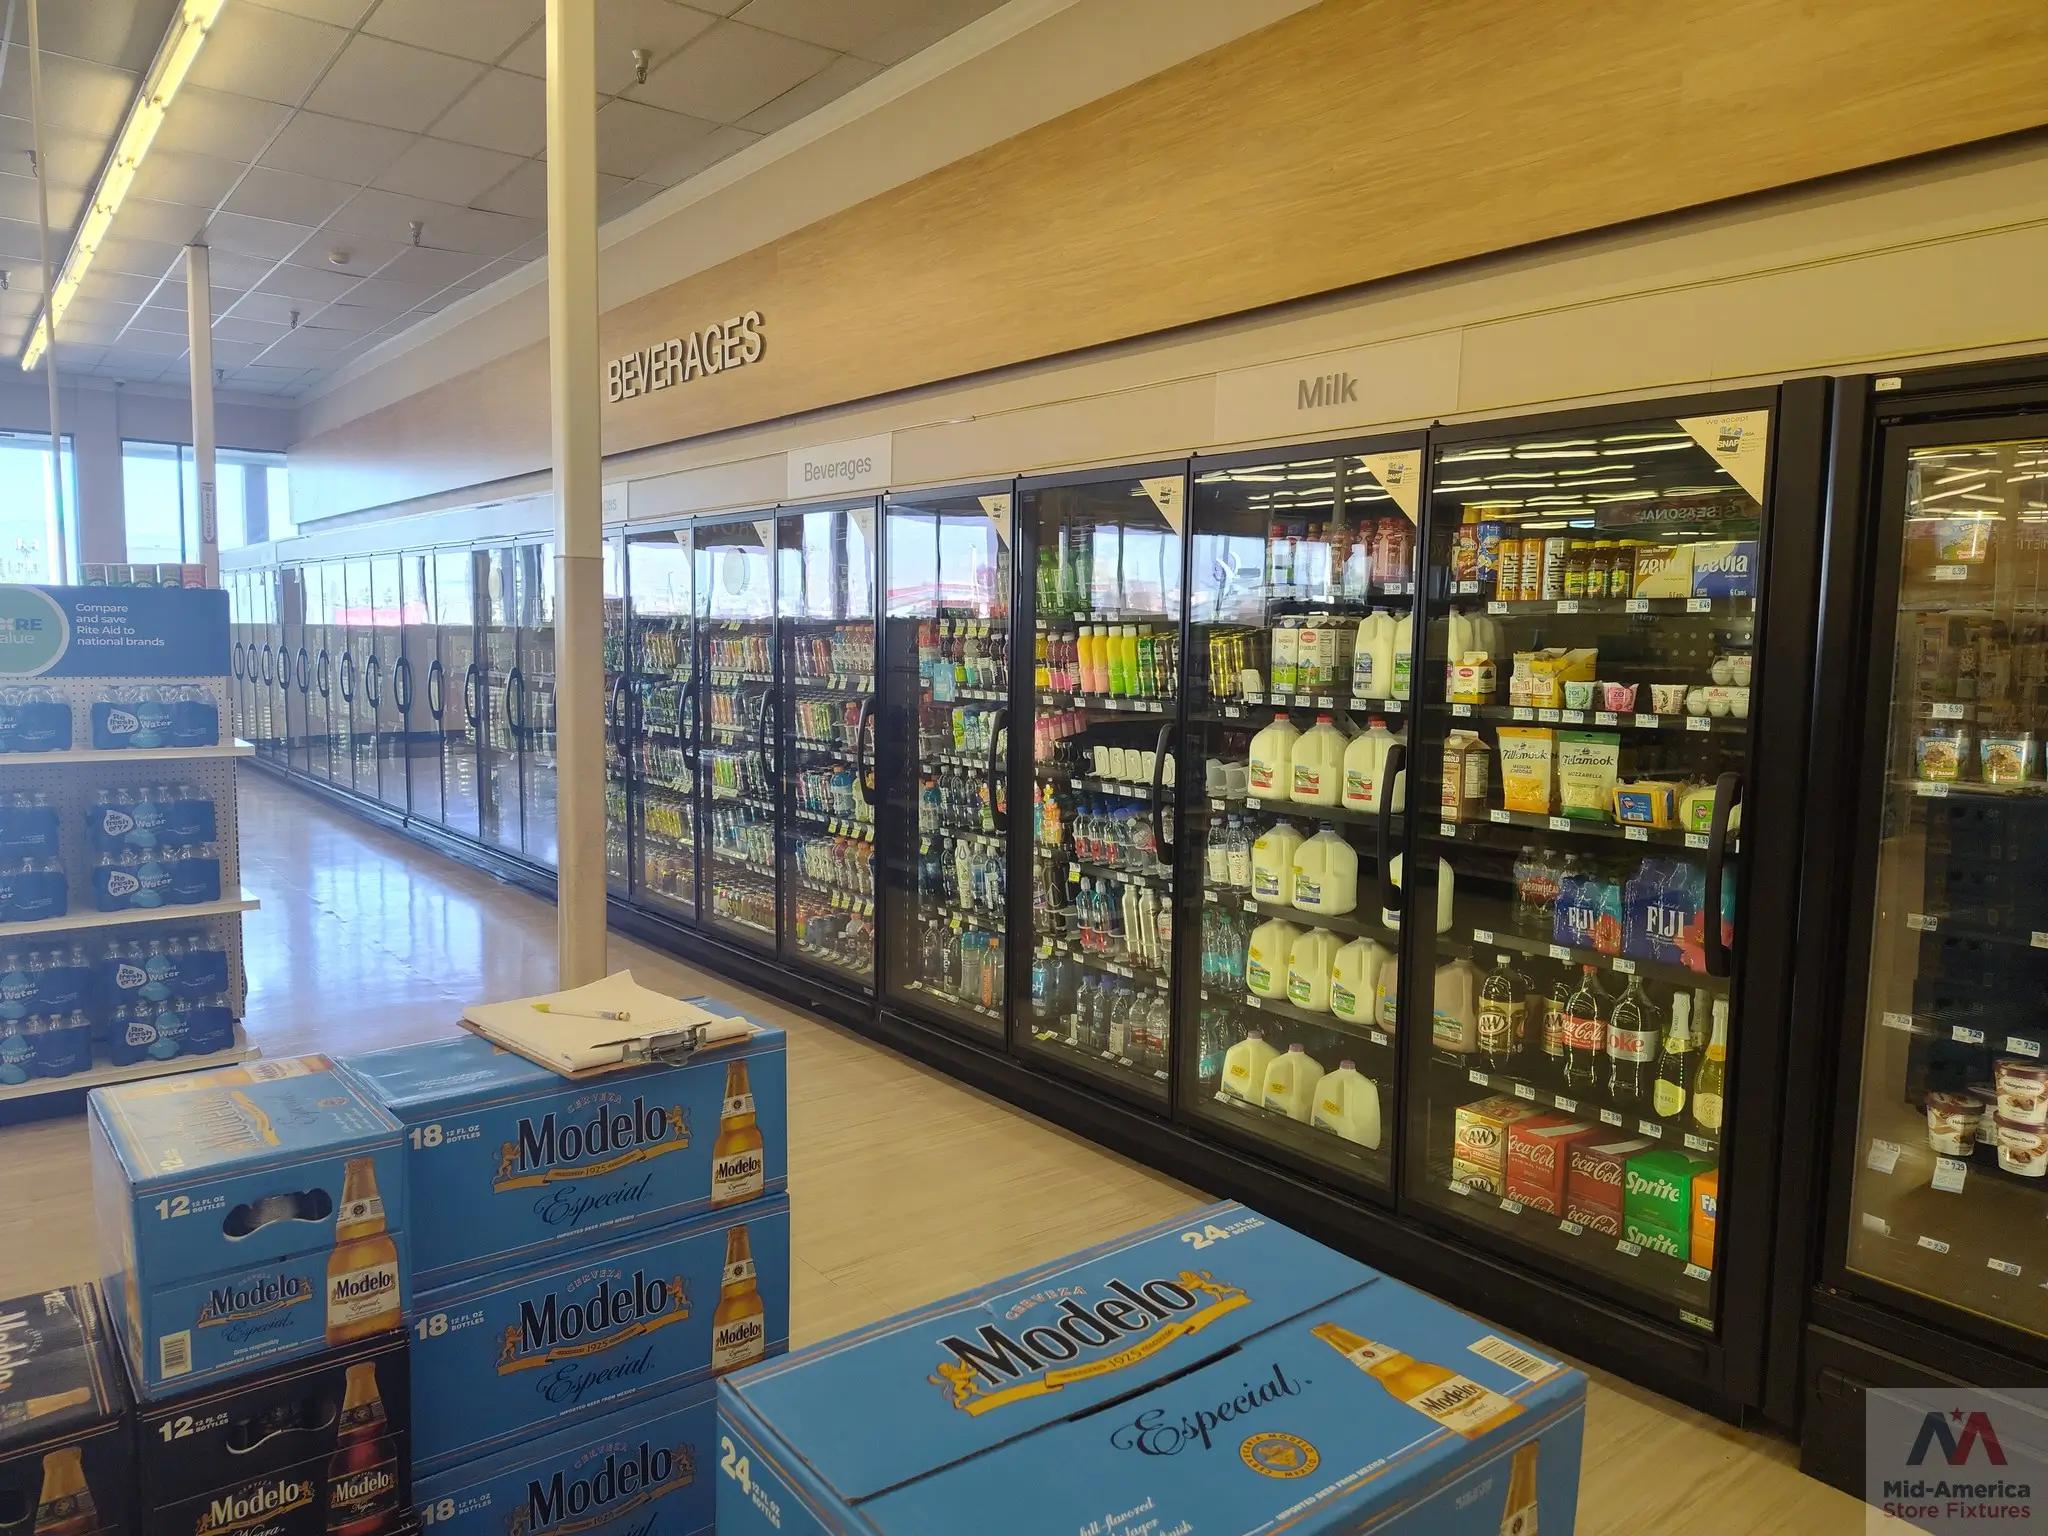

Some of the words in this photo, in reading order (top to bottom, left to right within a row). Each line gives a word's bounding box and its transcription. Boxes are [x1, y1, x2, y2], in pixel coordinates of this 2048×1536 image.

[607, 310, 765, 402] BEVERAGES
[1297, 371, 1358, 410] Milk
[1717, 440, 1740, 449] SNAP
[804, 456, 872, 482] Beverages
[75, 603, 129, 614] Compare
[76, 615, 99, 624] and
[100, 616, 127, 624] save
[0, 633, 35, 644] alue
[77, 626, 99, 635] Rite
[102, 626, 121, 635] Aid
[123, 626, 135, 635] to
[77, 637, 123, 646] national
[126, 637, 165, 646] brands
[1949, 705, 1963, 713] 6.99
[1503, 749, 1548, 760] Tillamook
[1562, 754, 1614, 766] Tillamook
[1522, 883, 1560, 894] ARROWHEA
[1568, 907, 1594, 930] FIJI
[1647, 906, 1685, 938] FIJI
[3, 989, 39, 999] Water
[1968, 1030, 1983, 1038] 7.29
[2024, 1043, 2039, 1051] 7.29
[409, 1124, 443, 1150] 18
[446, 1132, 481, 1143] BOTTLES
[517, 1095, 668, 1172] Modelo
[719, 1157, 756, 1179] Modelo
[1952, 1162, 1965, 1171] 7.29
[1626, 1171, 1680, 1202] Sprite
[155, 1195, 190, 1220] 12
[1181, 1224, 1231, 1250] 24
[1627, 1225, 1679, 1258] Sprite
[337, 1271, 390, 1299] Modelo
[567, 1268, 623, 1292] CERVEZA
[210, 1274, 300, 1317] Modelo
[1004, 1286, 1088, 1320] CERVEZA
[519, 1269, 669, 1353] Modelo
[415, 1313, 448, 1341] 18
[451, 1317, 485, 1331] BOTTLES
[720, 1325, 759, 1346] Modelo
[936, 1278, 1197, 1387] Modelo
[587, 1341, 608, 1352] 1925
[1108, 1348, 1143, 1369] 1925
[559, 1403, 587, 1416] IMPORTED
[587, 1399, 600, 1409] BEER
[601, 1394, 616, 1405] FROM
[617, 1388, 636, 1398] MEXICO
[1420, 1384, 1477, 1412] Modelo
[159, 1416, 194, 1442] 12
[196, 1418, 229, 1433] BOTTLES
[721, 1436, 751, 1495] 24
[336, 1472, 389, 1502] Modelo
[526, 1439, 672, 1532] Modelo
[211, 1479, 300, 1528] Modelo
[422, 1499, 455, 1525] 18
[459, 1499, 493, 1515] BOTTLES
